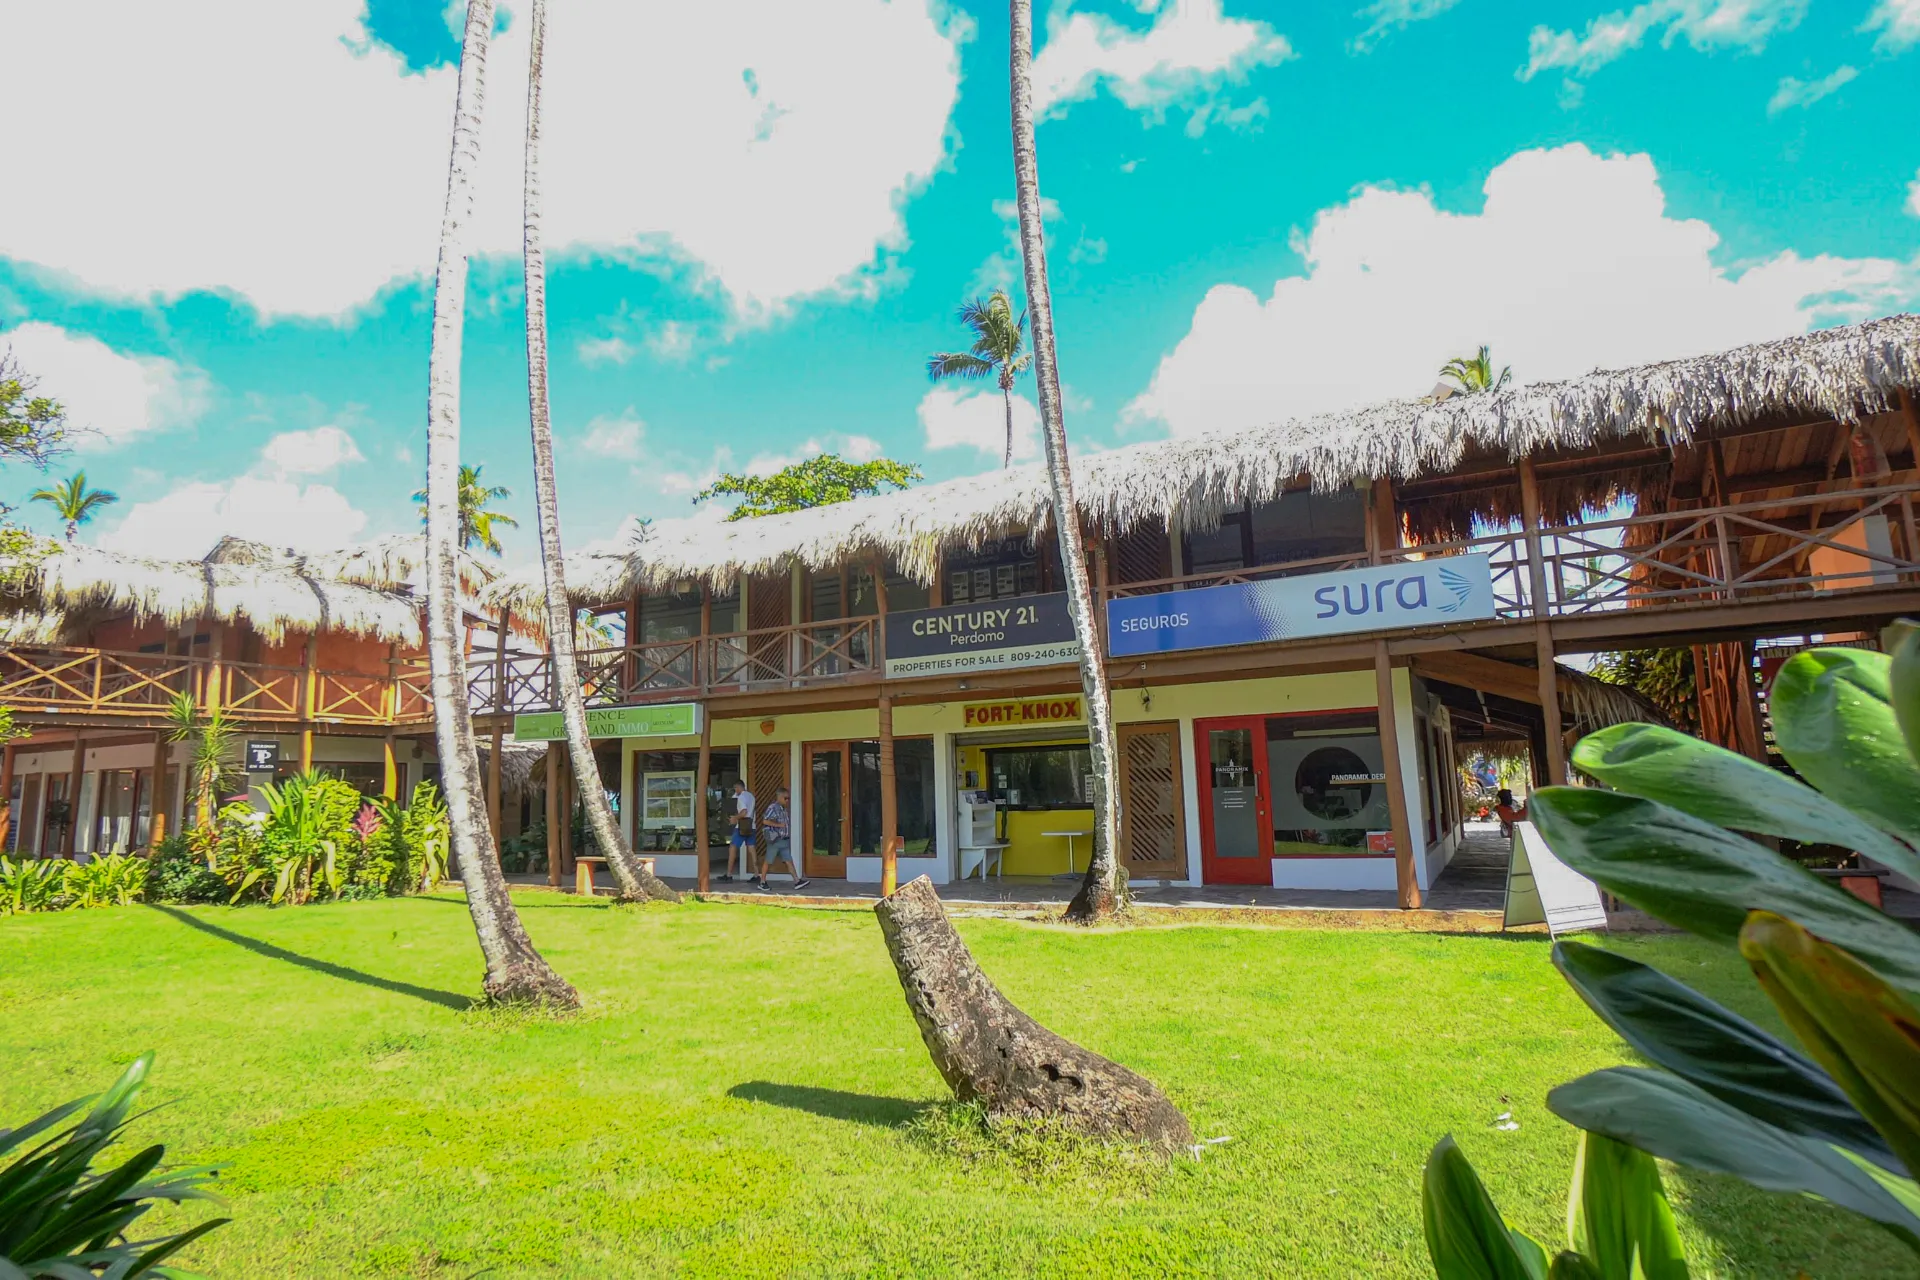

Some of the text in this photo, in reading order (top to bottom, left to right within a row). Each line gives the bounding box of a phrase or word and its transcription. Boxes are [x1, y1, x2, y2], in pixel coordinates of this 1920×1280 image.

[1314, 575, 1428, 619] sura
[912, 608, 1011, 636] CENTURY
[1121, 612, 1189, 633] SEGUROS
[950, 631, 1005, 646] Perdomo
[893, 646, 1080, 673] PROPERTIES FOR SALE 809-240-630
[585, 710, 626, 721] ENCE
[965, 700, 1078, 724] FORT-KNOX
[1331, 772, 1386, 781] PANORAMIX DESI
